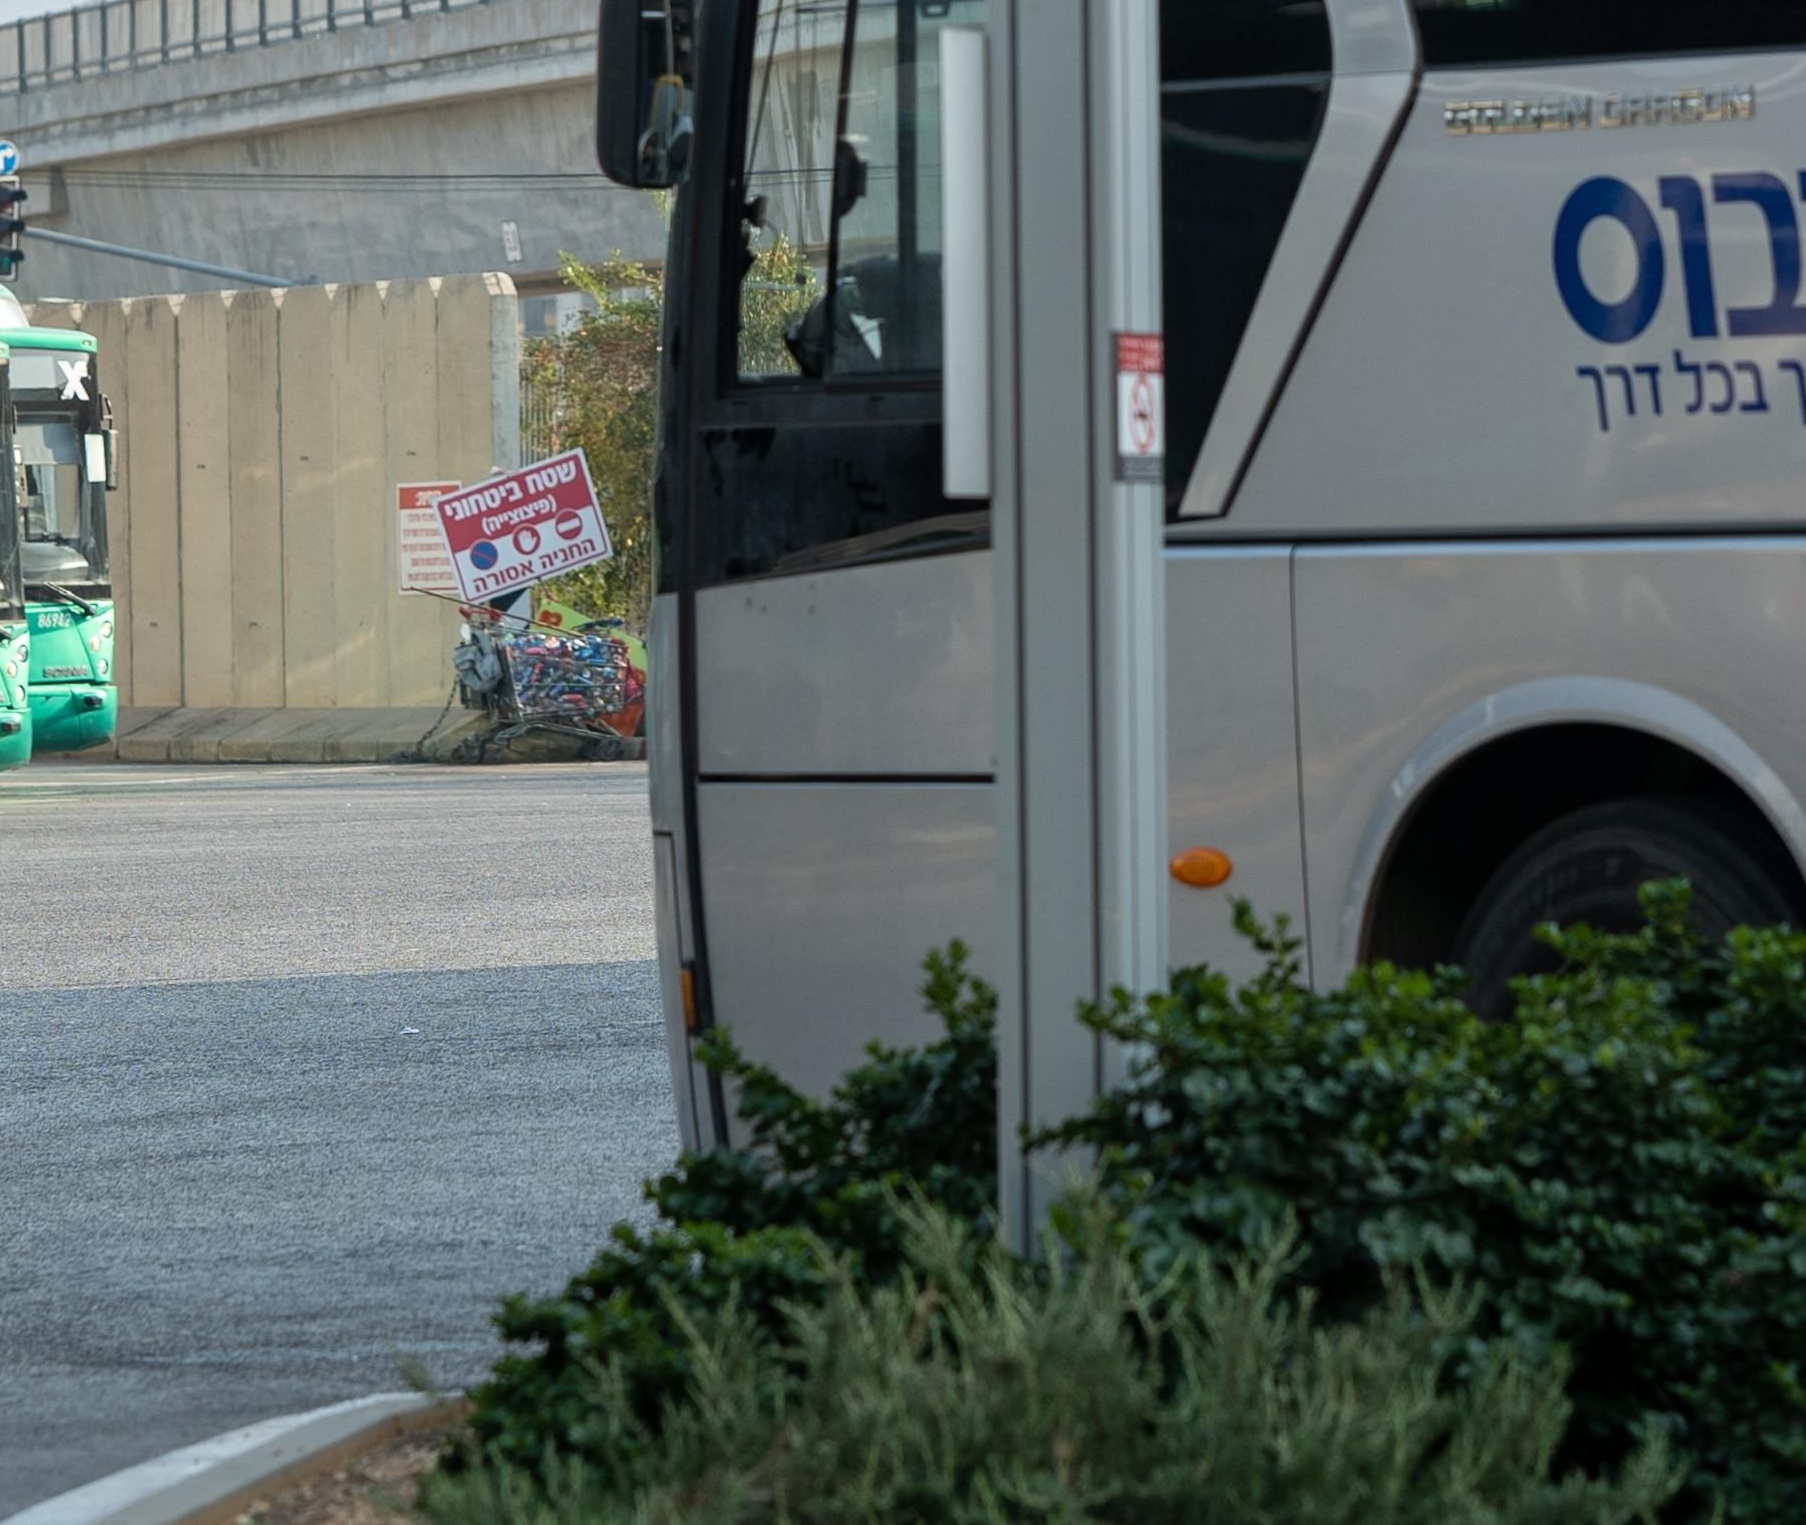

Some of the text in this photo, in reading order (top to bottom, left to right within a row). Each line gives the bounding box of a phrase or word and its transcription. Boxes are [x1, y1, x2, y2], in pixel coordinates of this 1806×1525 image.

[1576, 363, 1662, 432] דרך
[1674, 349, 1770, 415] בכל
[444, 480, 524, 522] ביטחוני
[524, 460, 577, 495] שטח
[473, 538, 597, 594] החניה אסורה
